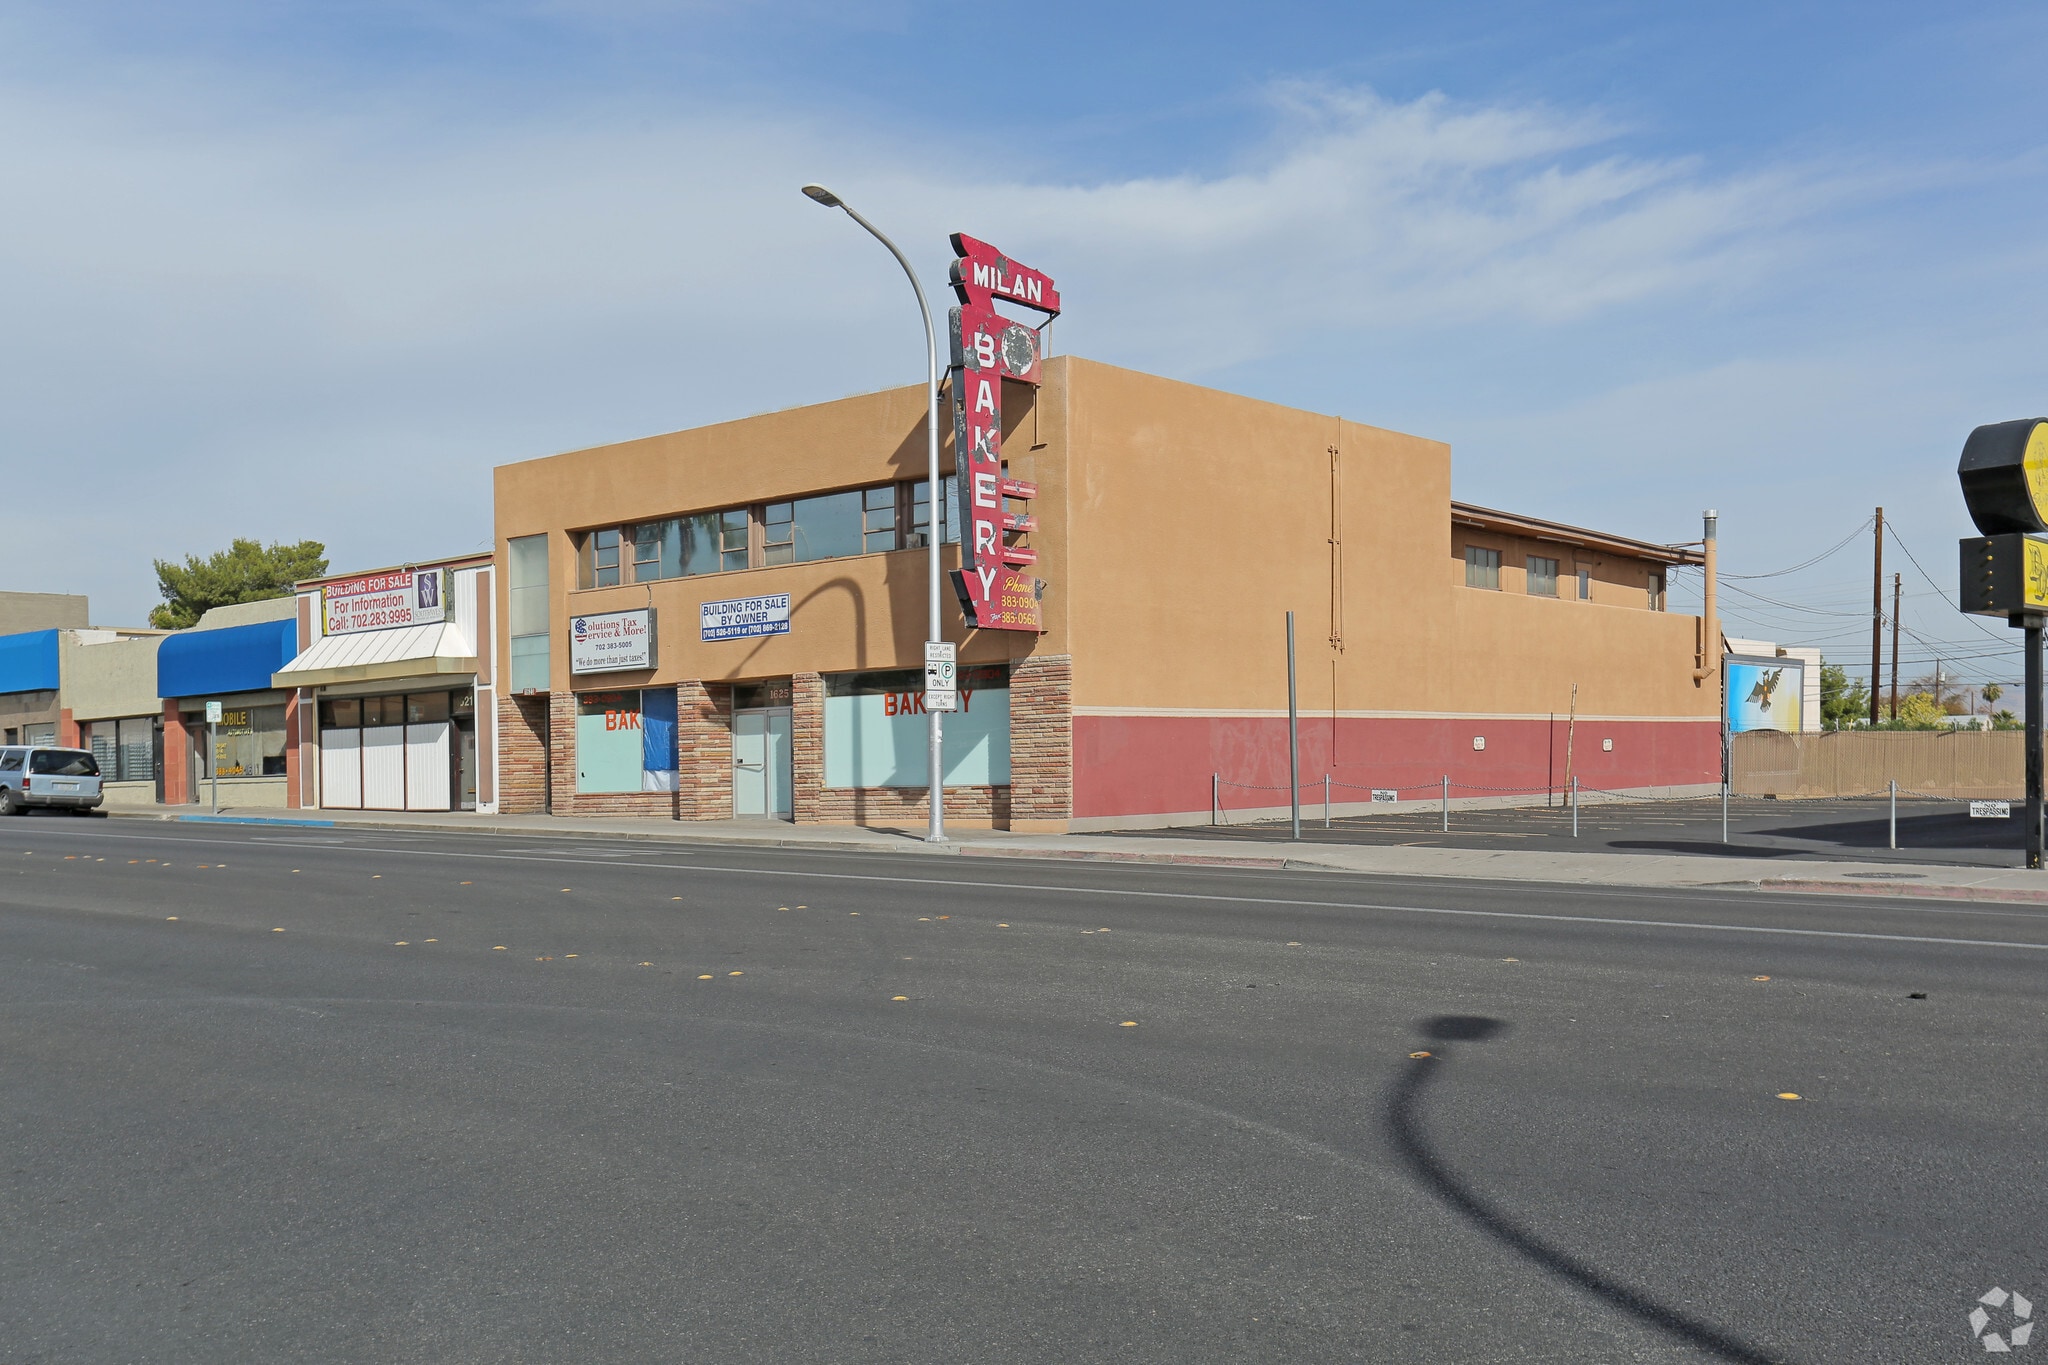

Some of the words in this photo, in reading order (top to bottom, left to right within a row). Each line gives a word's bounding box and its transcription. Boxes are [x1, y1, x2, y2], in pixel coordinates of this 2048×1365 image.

[973, 262, 1042, 303] MILAN
[974, 332, 998, 602] BAKERY
[326, 581, 366, 597] BUILDING
[368, 578, 386, 591] FOR
[388, 573, 412, 588] SALE
[1003, 575, 1034, 595] Phone
[334, 600, 349, 614] For
[351, 594, 404, 612] Information
[703, 602, 742, 616] BUILDING
[745, 600, 762, 611] FOR
[764, 597, 787, 609] SALE
[328, 615, 349, 631] Call:
[351, 608, 412, 628] 702.283.9995
[622, 618, 637, 627] Tax
[721, 615, 732, 625] BY
[735, 611, 768, 624] OWNER
[614, 628, 621, 637] &
[623, 624, 647, 637] More!
[607, 641, 633, 650] 383-5005
[586, 657, 593, 666] do
[593, 658, 606, 666] more
[606, 655, 618, 664] than
[618, 654, 629, 665] just
[932, 679, 950, 687] ONLY
[770, 688, 789, 700] 1625
[884, 687, 973, 716] BAKY
[1971, 807, 2009, 816] TRESPASSING
